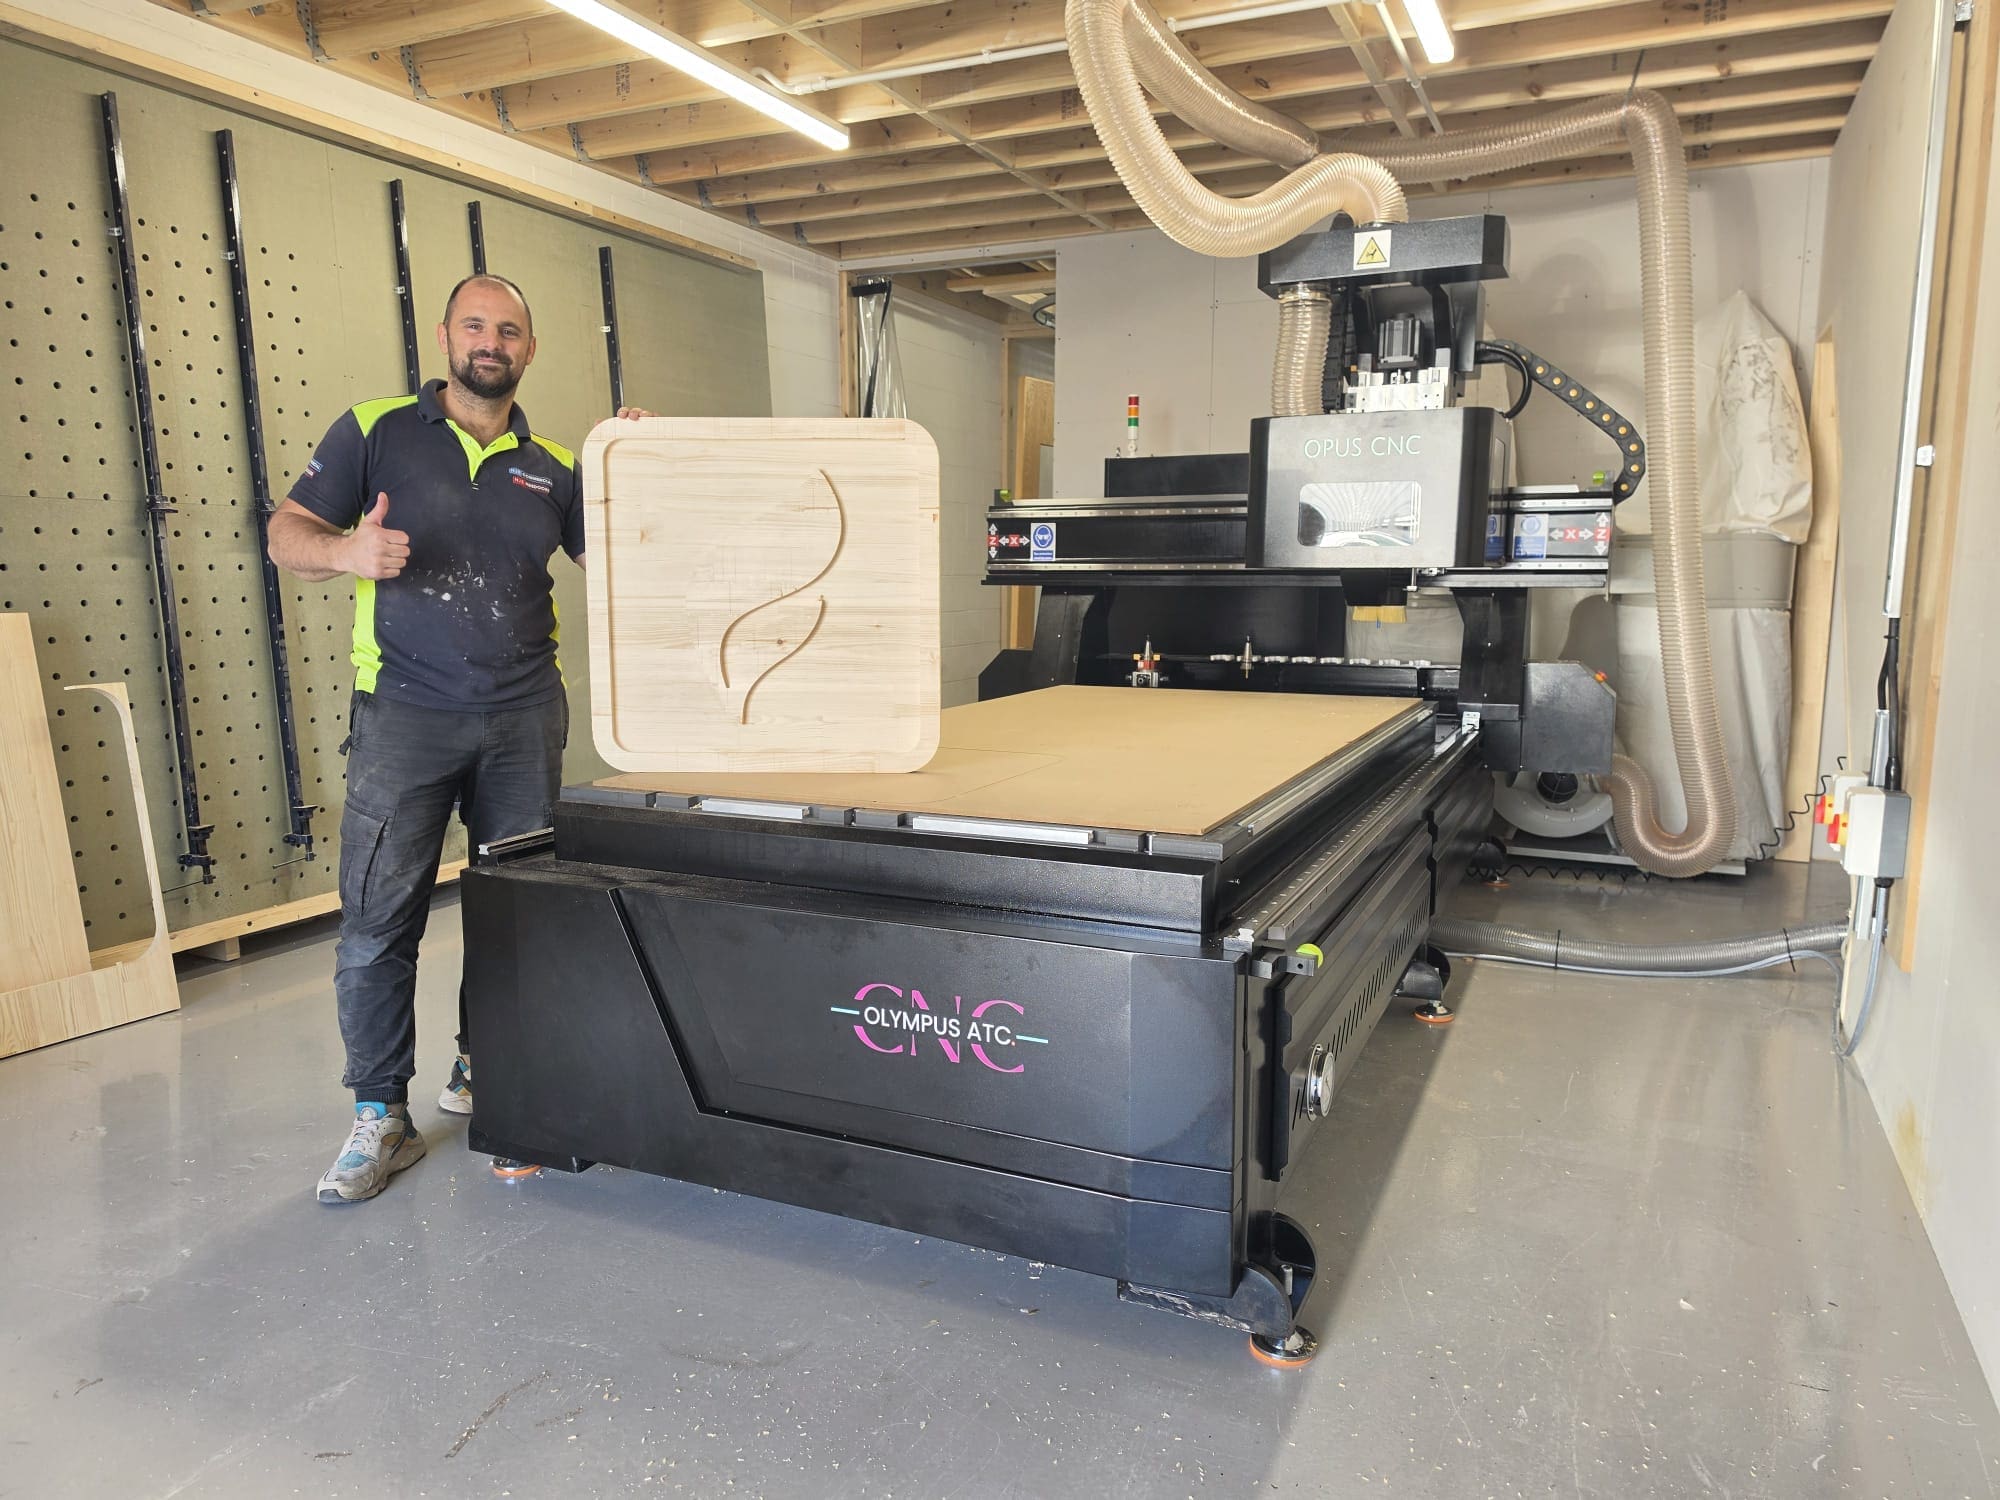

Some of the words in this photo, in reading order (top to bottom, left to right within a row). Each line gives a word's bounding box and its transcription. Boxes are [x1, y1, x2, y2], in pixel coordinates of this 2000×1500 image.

[1304, 437, 1362, 458] OPUS
[1371, 435, 1422, 457] CNC
[1565, 529, 1578, 540] X
[1596, 528, 1607, 540] Z
[989, 536, 997, 545] Z
[1009, 536, 1019, 545] X
[853, 983, 1025, 1073] CNC
[863, 1006, 962, 1038] OLYMPUS
[966, 1022, 1016, 1046] ATC.
